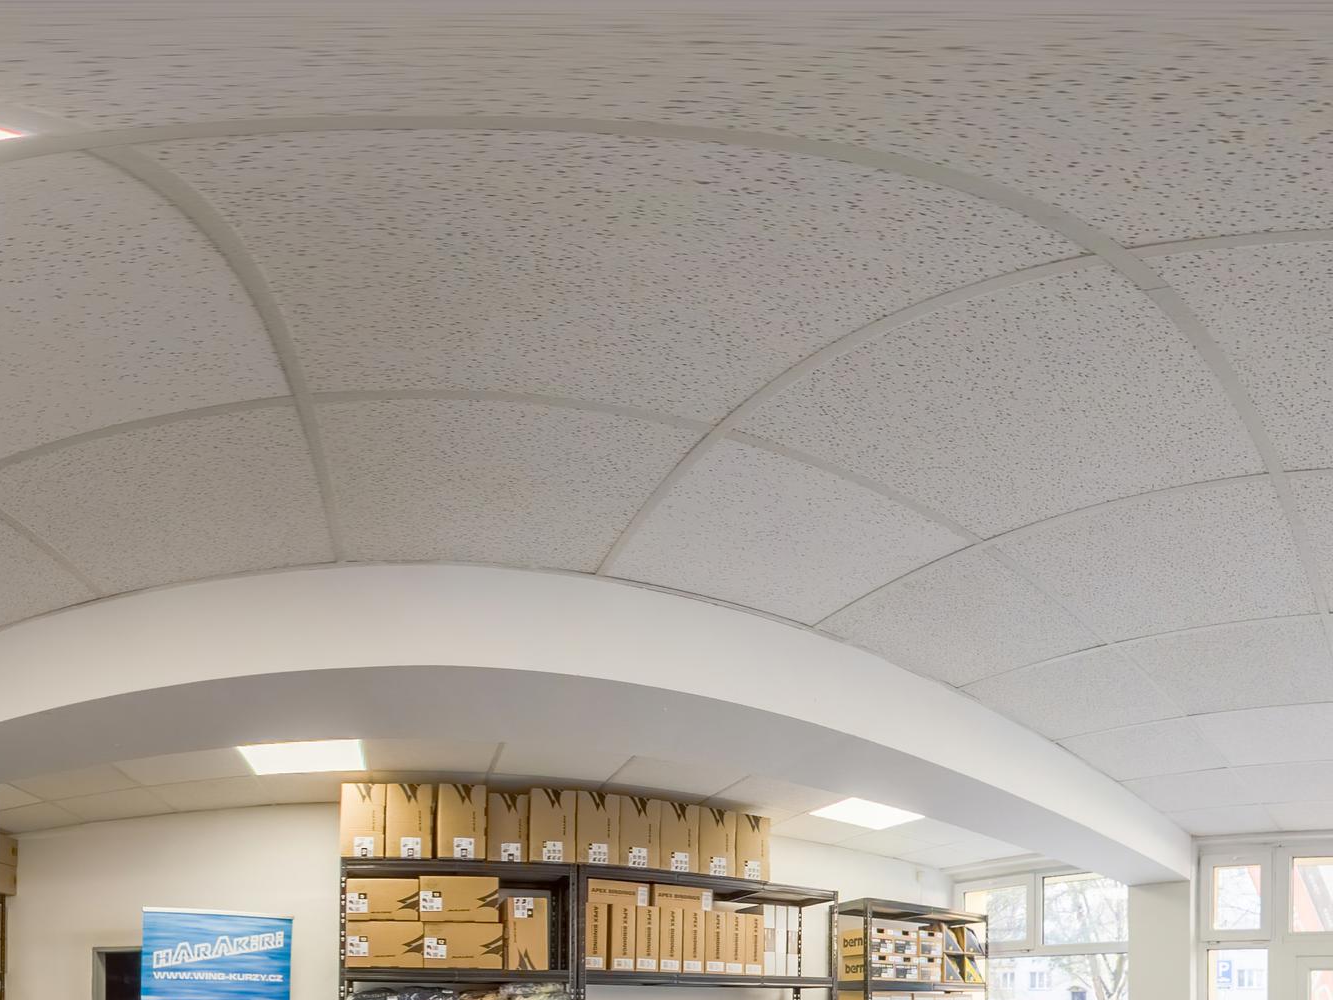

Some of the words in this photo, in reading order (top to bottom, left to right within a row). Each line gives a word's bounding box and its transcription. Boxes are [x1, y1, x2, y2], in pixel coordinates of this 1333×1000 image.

[843, 934, 863, 948] bern
[1220, 963, 1231, 976] P
[153, 971, 284, 982] WWW.WING-KURZY.CZ
